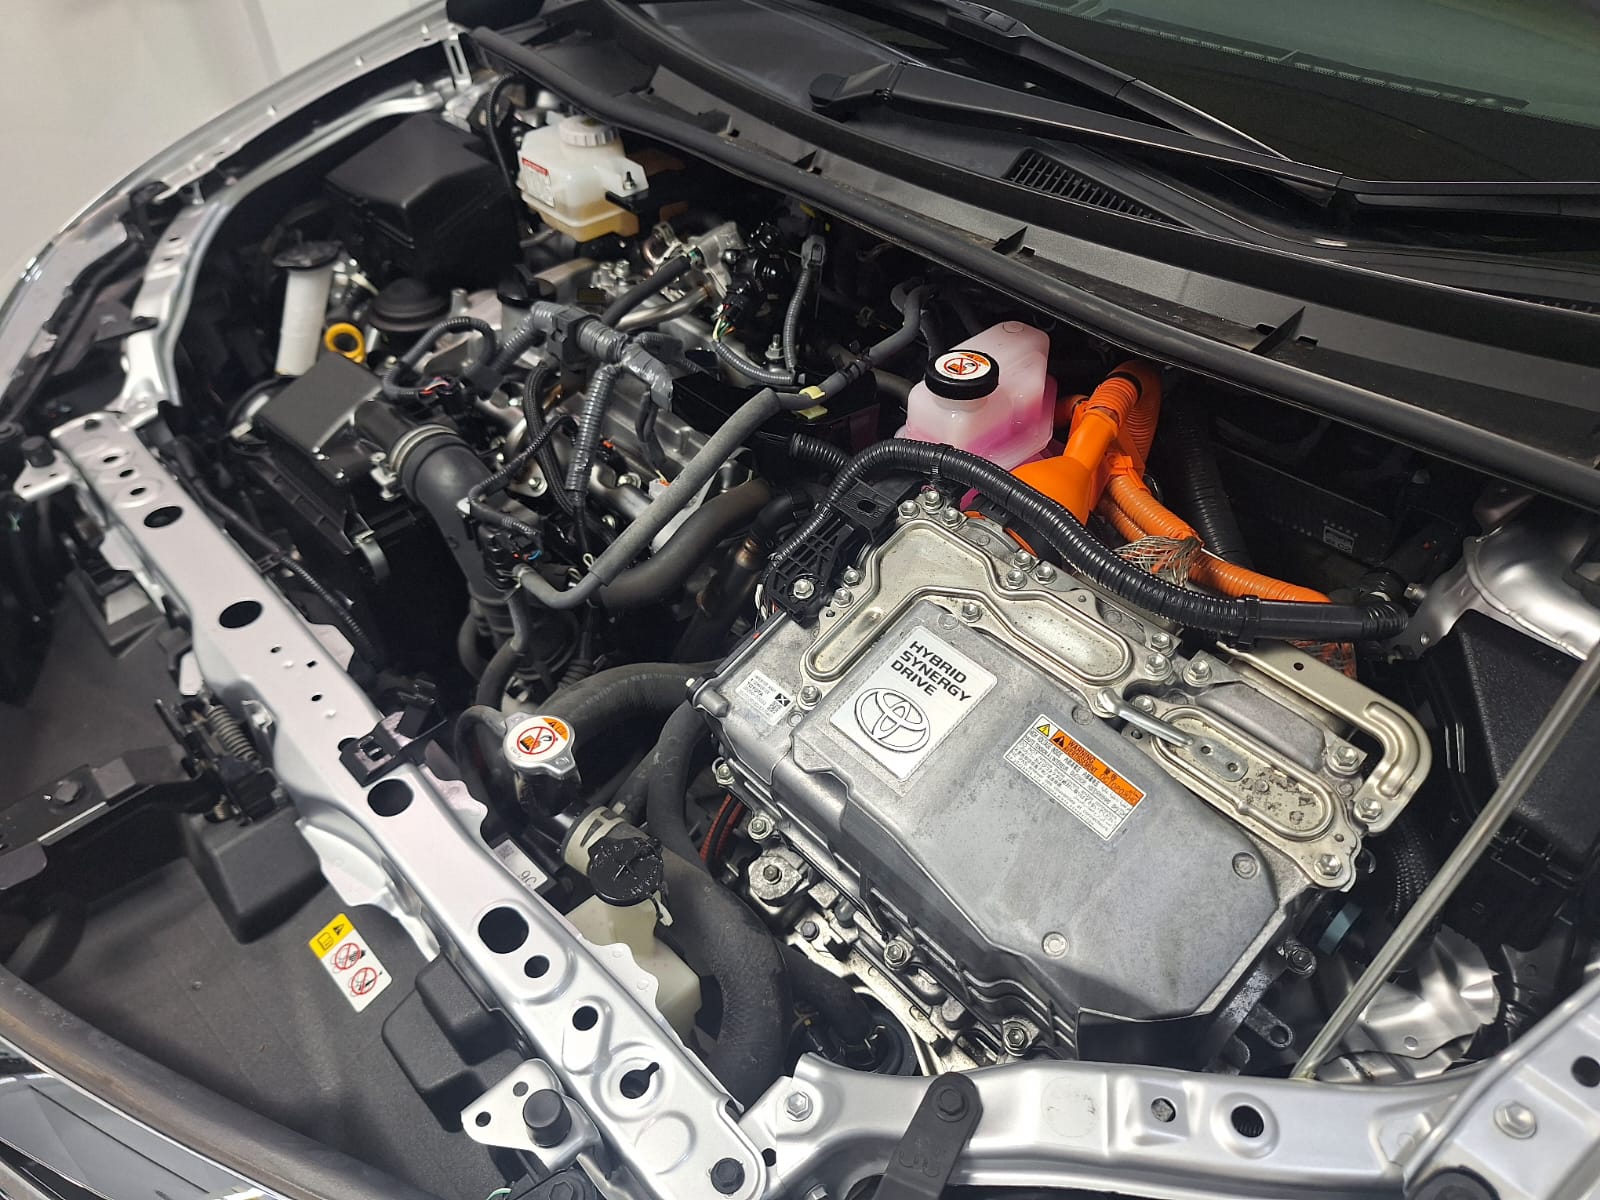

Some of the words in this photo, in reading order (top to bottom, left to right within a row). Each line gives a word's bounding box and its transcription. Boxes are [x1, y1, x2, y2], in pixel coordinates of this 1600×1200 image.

[891, 660, 937, 696] DRIVE
[900, 651, 972, 701] SYNERGY
[909, 640, 967, 683] HYBRID
[1067, 740, 1095, 763] WARNING
